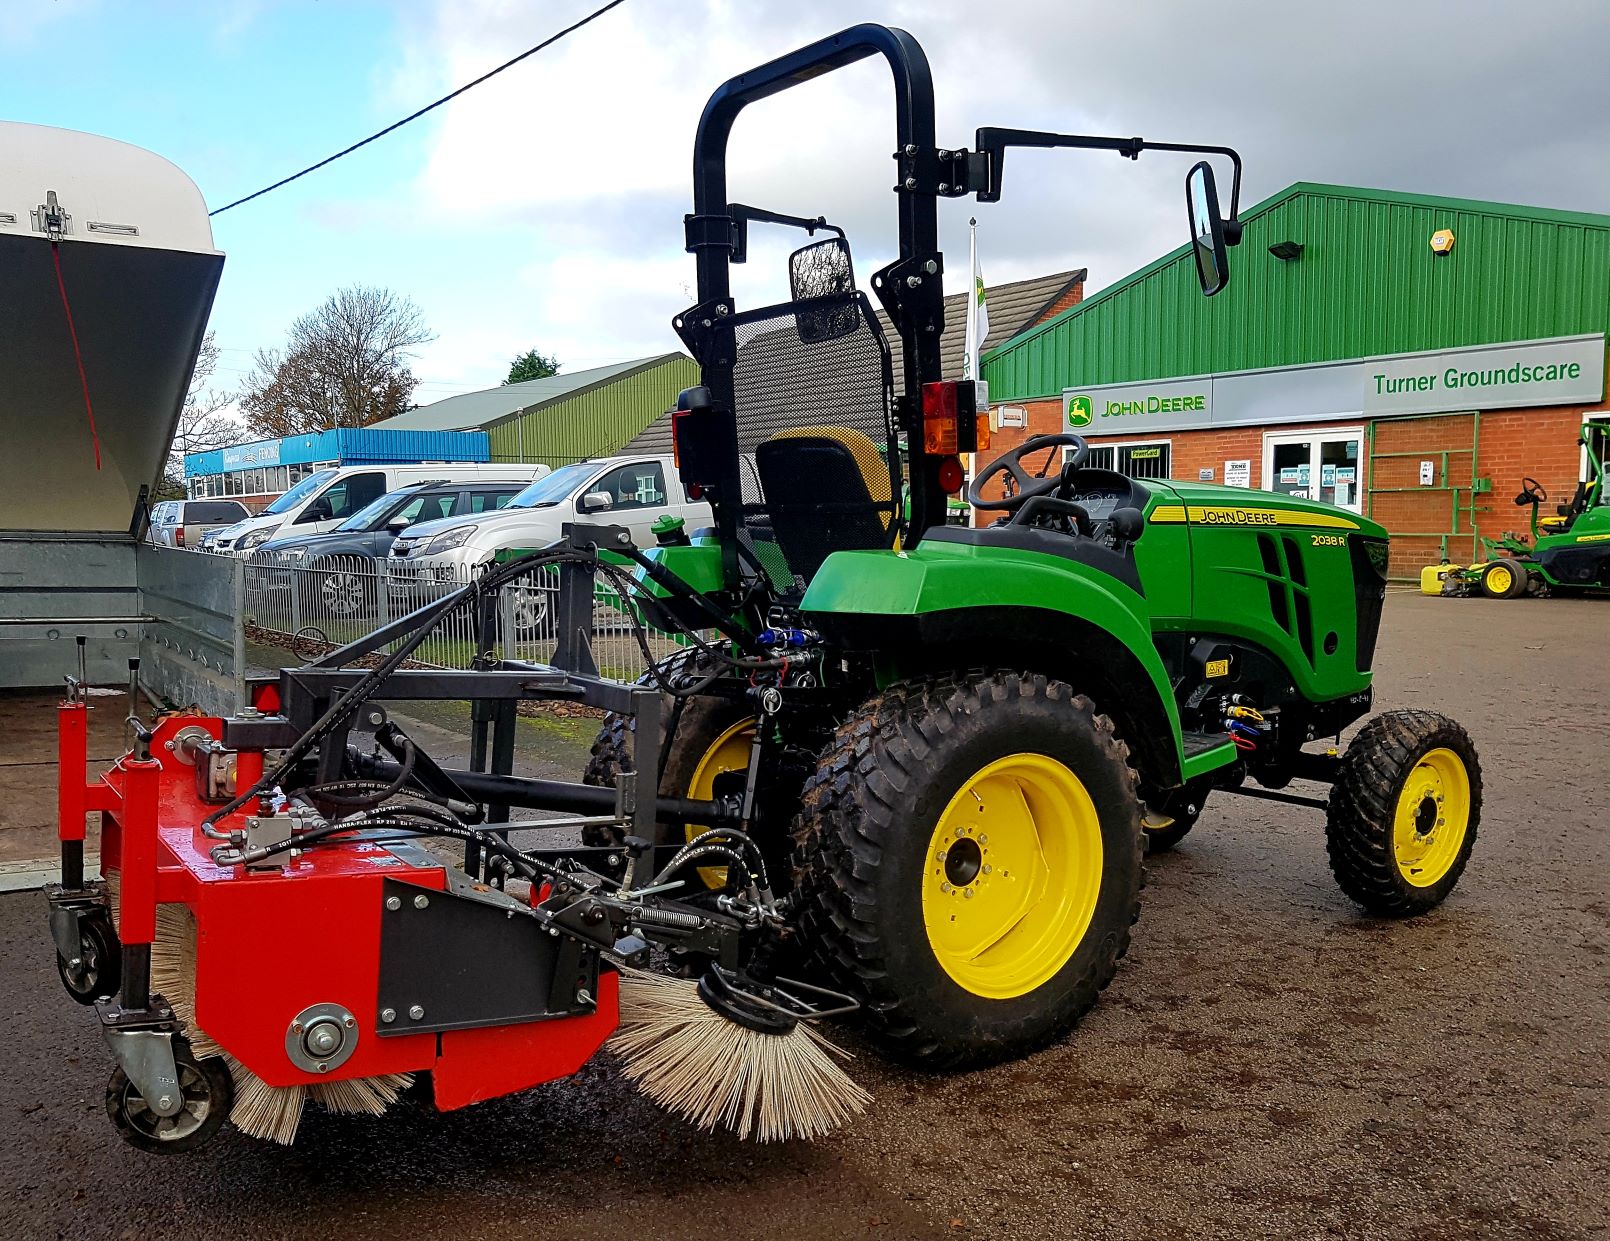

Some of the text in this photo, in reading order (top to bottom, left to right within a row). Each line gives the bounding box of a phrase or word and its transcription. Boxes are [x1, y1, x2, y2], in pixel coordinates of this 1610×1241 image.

[1373, 361, 1581, 395] Turner Groundscare
[1101, 395, 1206, 418] JOHN DEERE
[1200, 509, 1277, 524] JOHN DEERE
[1310, 534, 1338, 547] 2038
